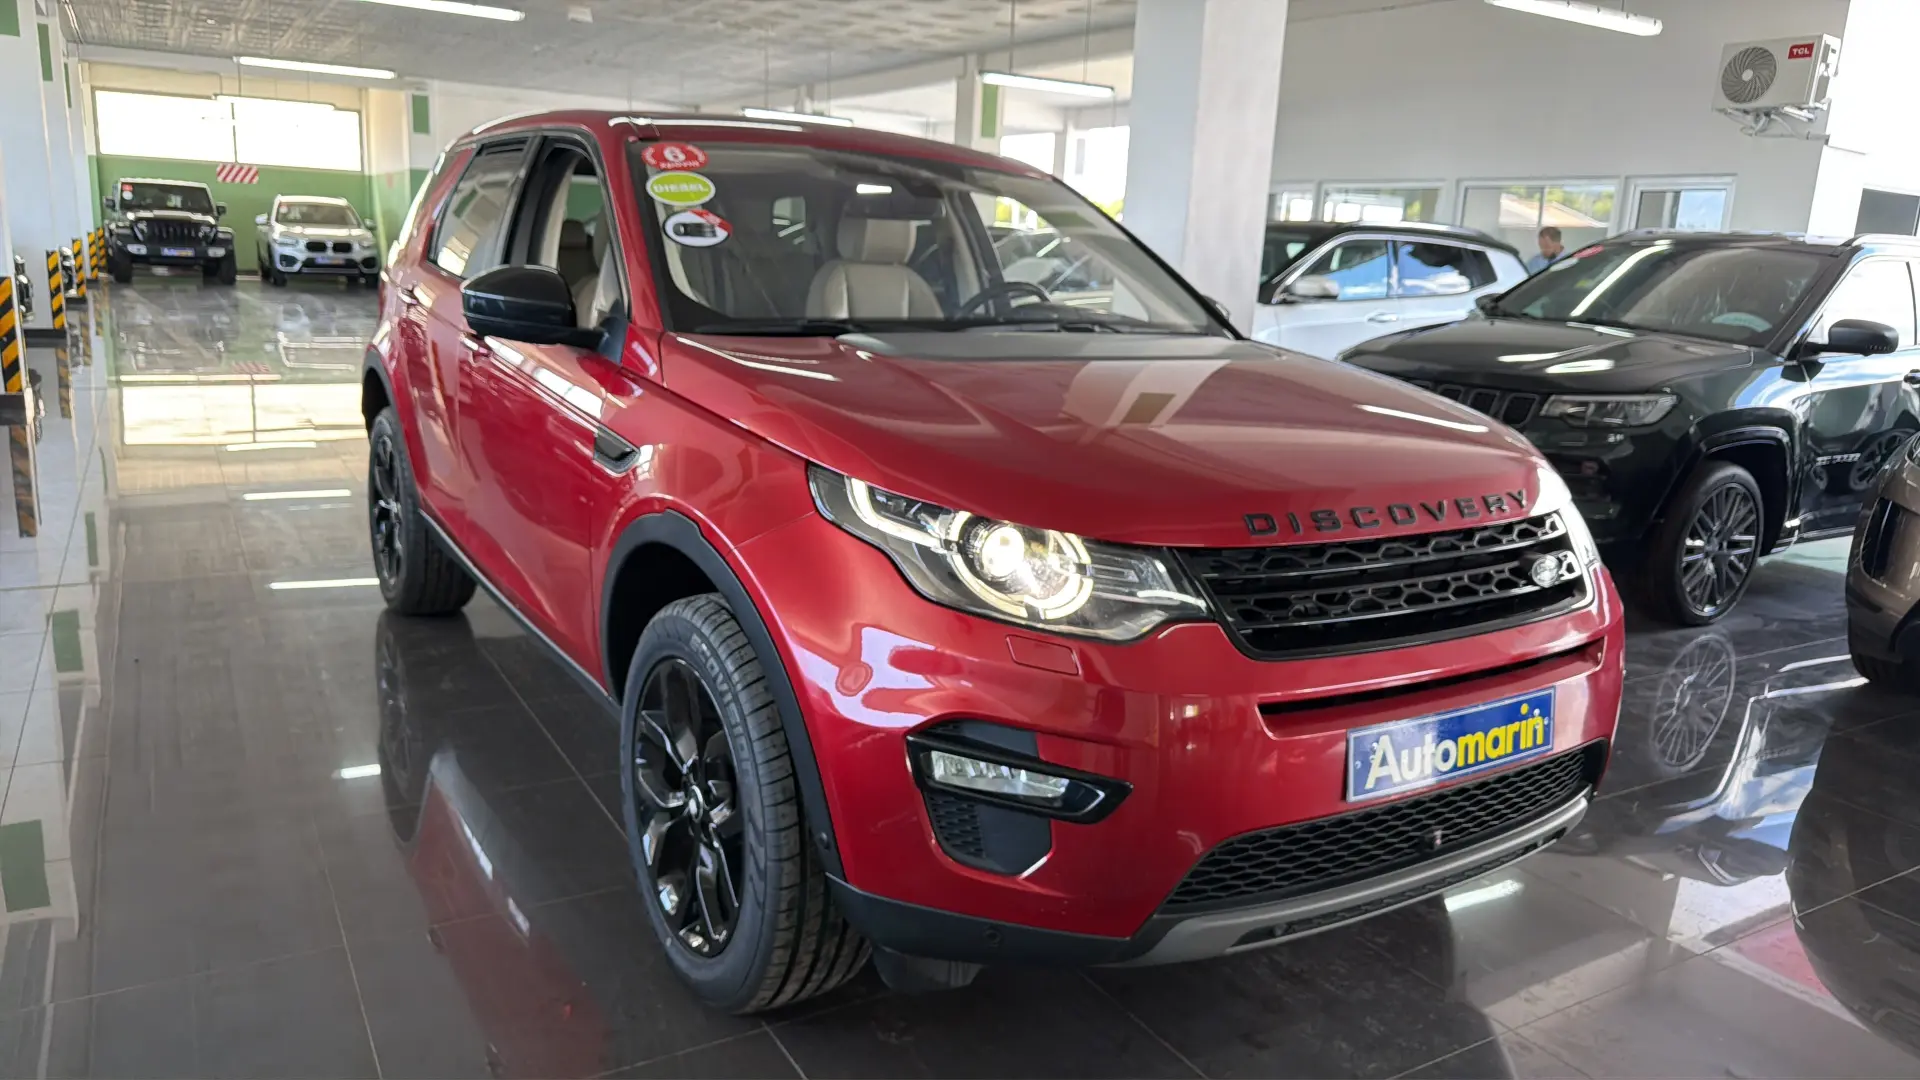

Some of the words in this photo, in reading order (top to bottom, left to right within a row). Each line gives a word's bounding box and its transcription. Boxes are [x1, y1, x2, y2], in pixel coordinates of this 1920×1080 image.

[1791, 47, 1811, 56] TCL
[652, 181, 709, 194] DIESEL
[1244, 489, 1529, 537] DISCOVERY
[1364, 703, 1544, 790] Automarin
